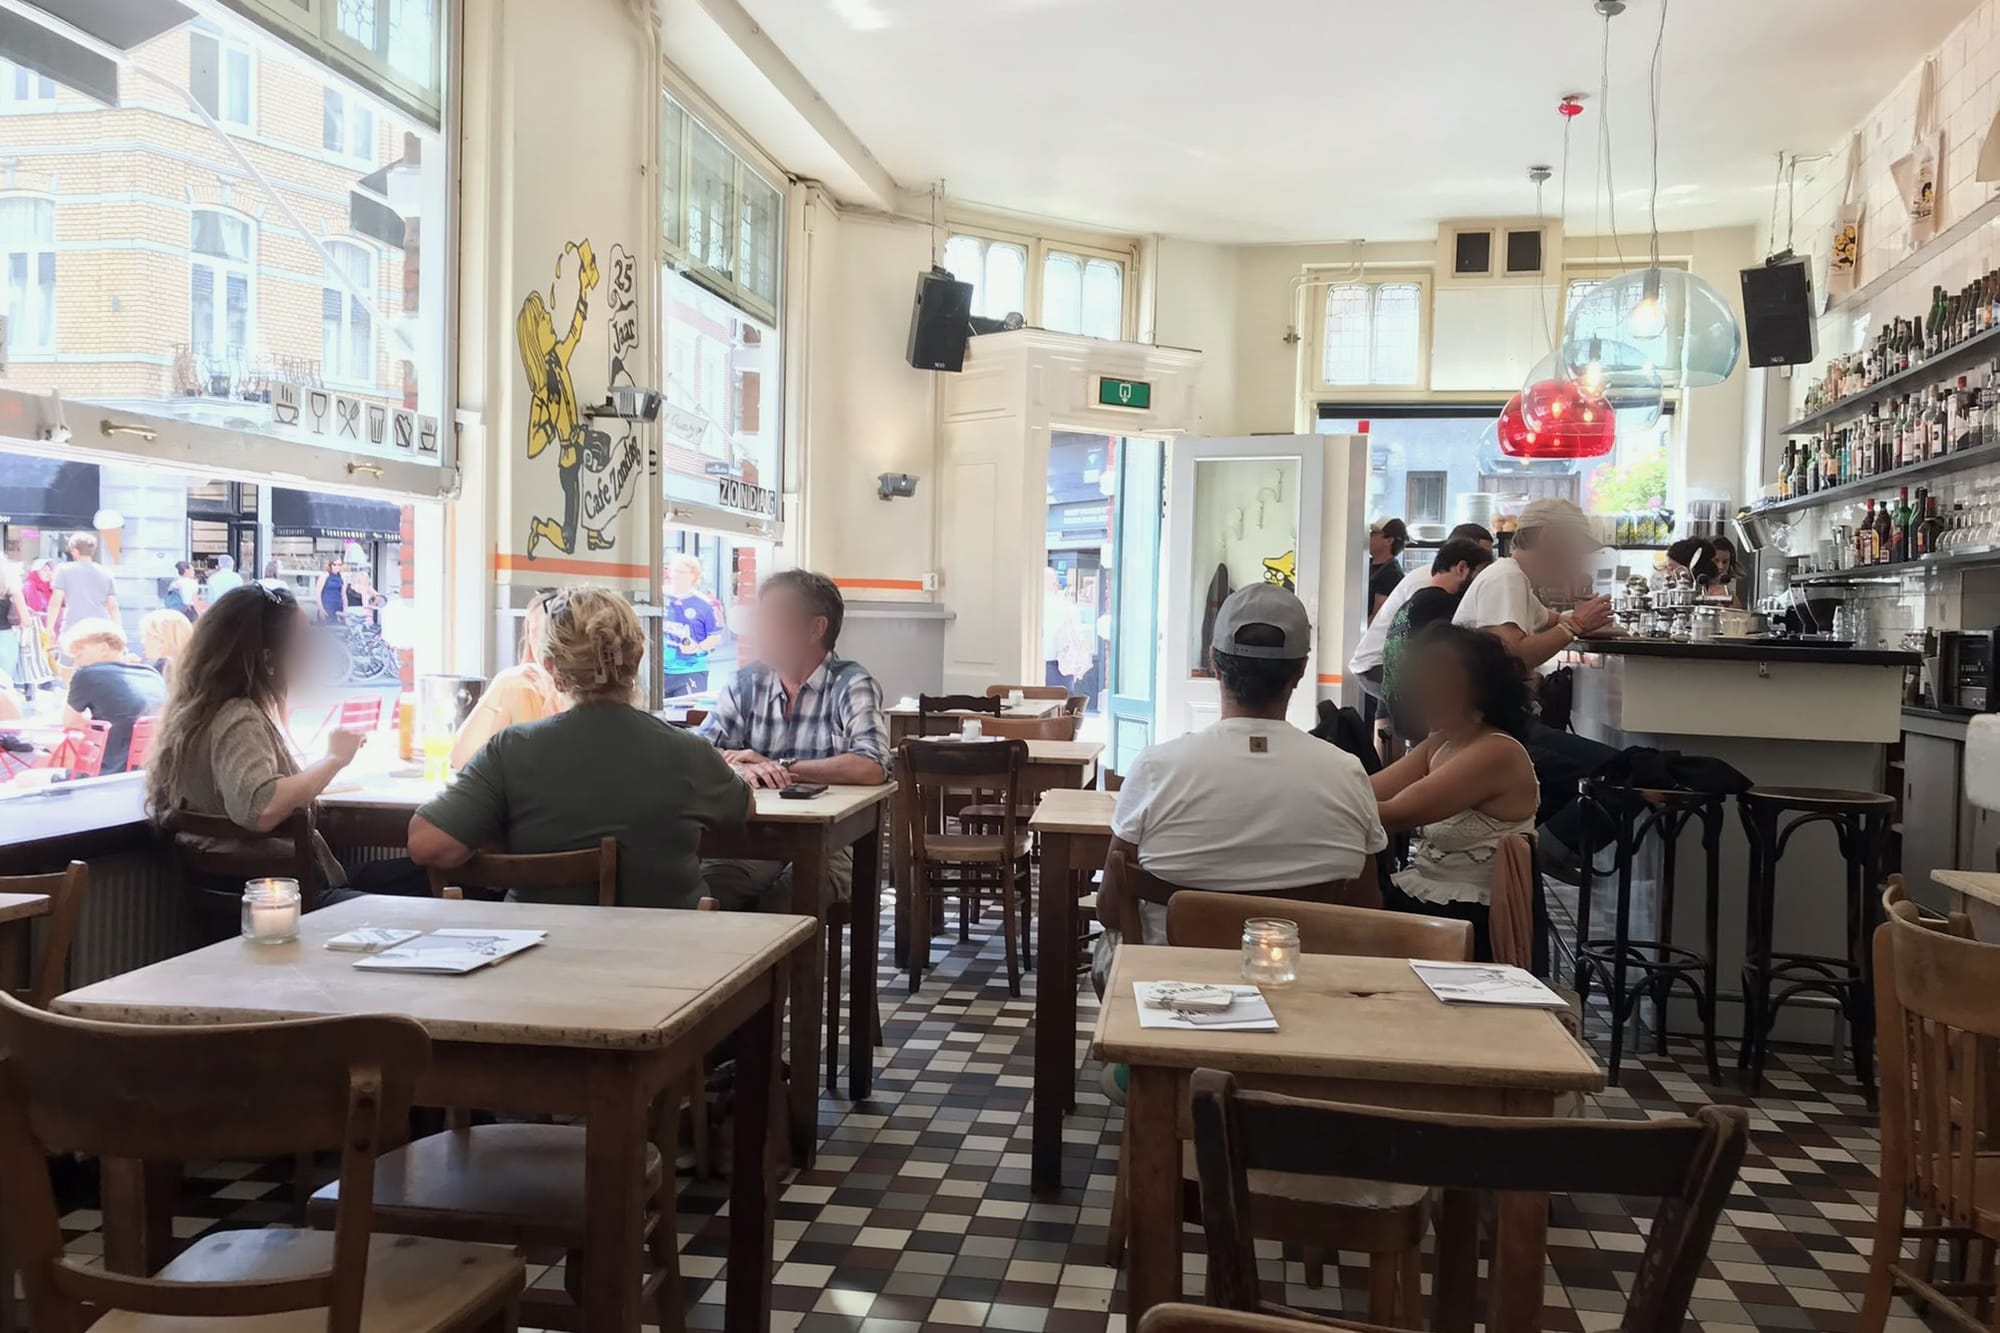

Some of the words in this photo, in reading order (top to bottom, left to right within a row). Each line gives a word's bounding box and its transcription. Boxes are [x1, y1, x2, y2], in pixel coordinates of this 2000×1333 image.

[614, 259, 632, 293] 25
[612, 319, 635, 354] Jaar
[609, 436, 641, 501] Zondag
[720, 478, 775, 515] ZONDAG
